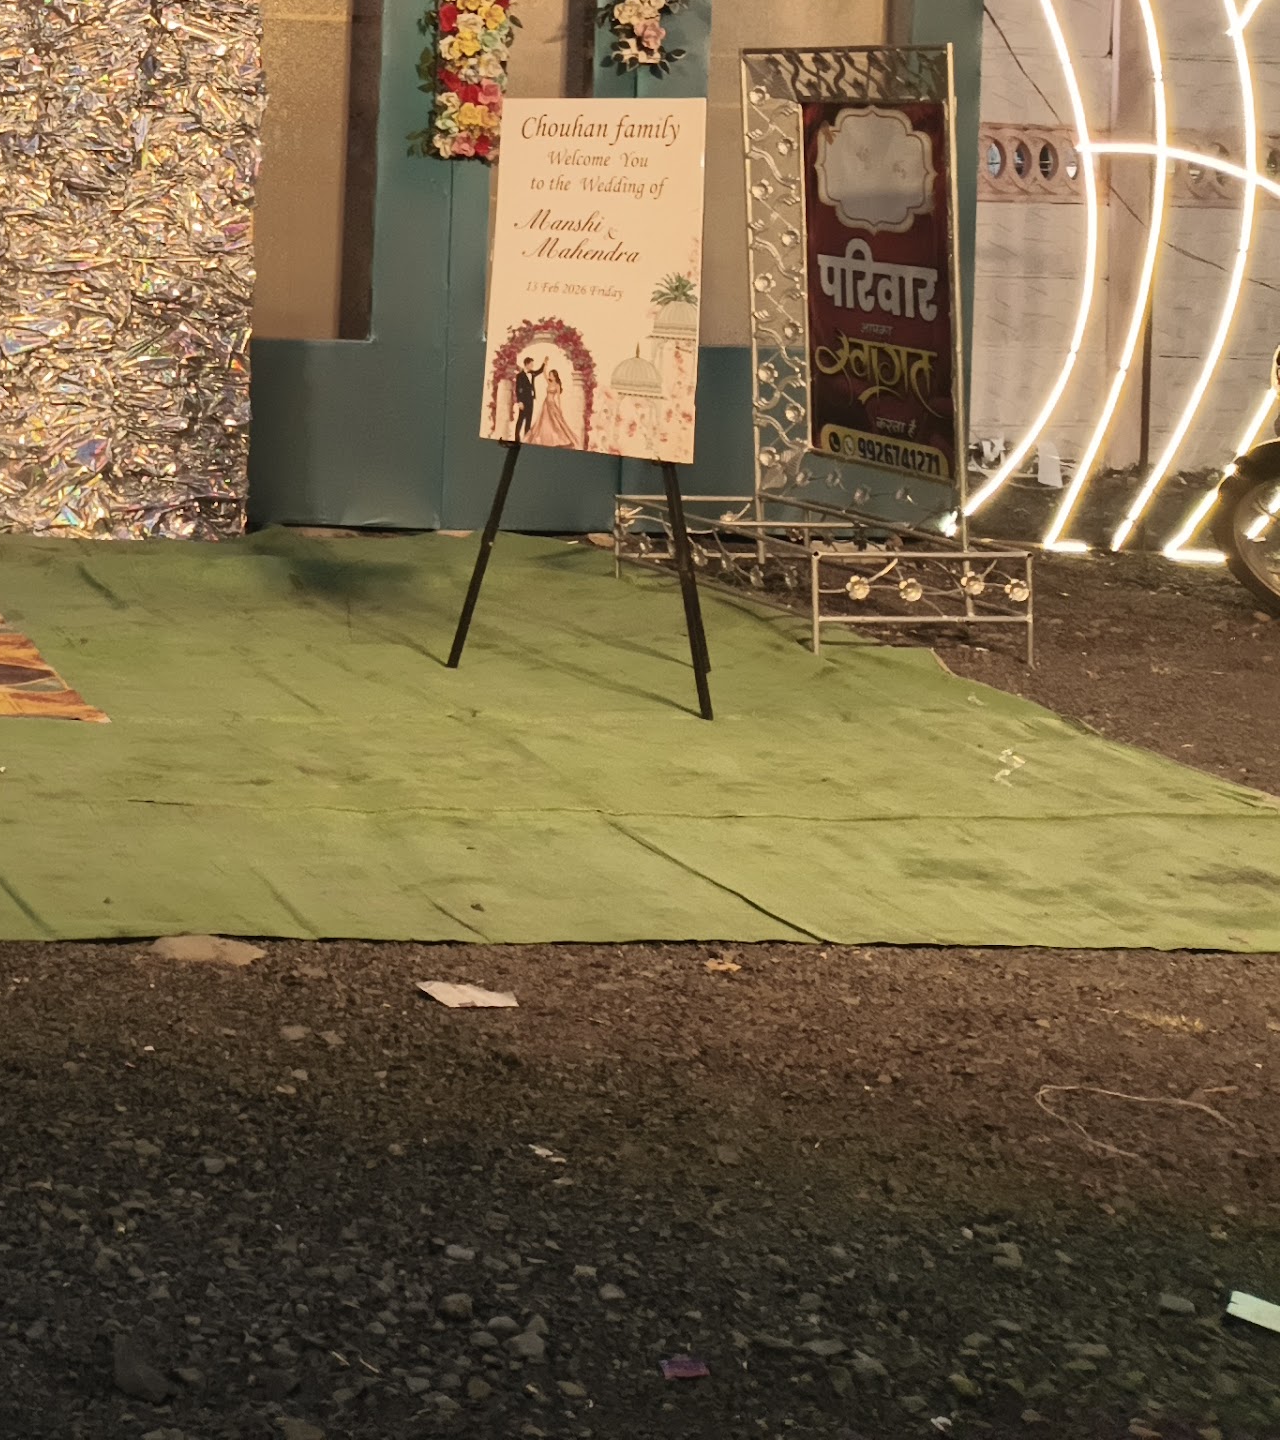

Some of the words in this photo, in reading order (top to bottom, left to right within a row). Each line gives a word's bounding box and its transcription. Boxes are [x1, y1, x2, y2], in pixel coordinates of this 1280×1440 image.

[521, 114, 609, 140] Chouhan
[608, 114, 681, 147] family
[547, 148, 611, 167] Welcome
[620, 151, 649, 168] You
[530, 177, 545, 191] to
[549, 174, 572, 191] the
[580, 175, 645, 200] Wedding
[649, 177, 669, 200] of
[513, 208, 605, 233] Manshi
[521, 237, 641, 263] Mahendra
[540, 281, 560, 294] Feb
[562, 283, 587, 295] 2026
[589, 284, 624, 301] Friday
[817, 238, 938, 322] परिवार
[815, 329, 945, 418] स्वागत
